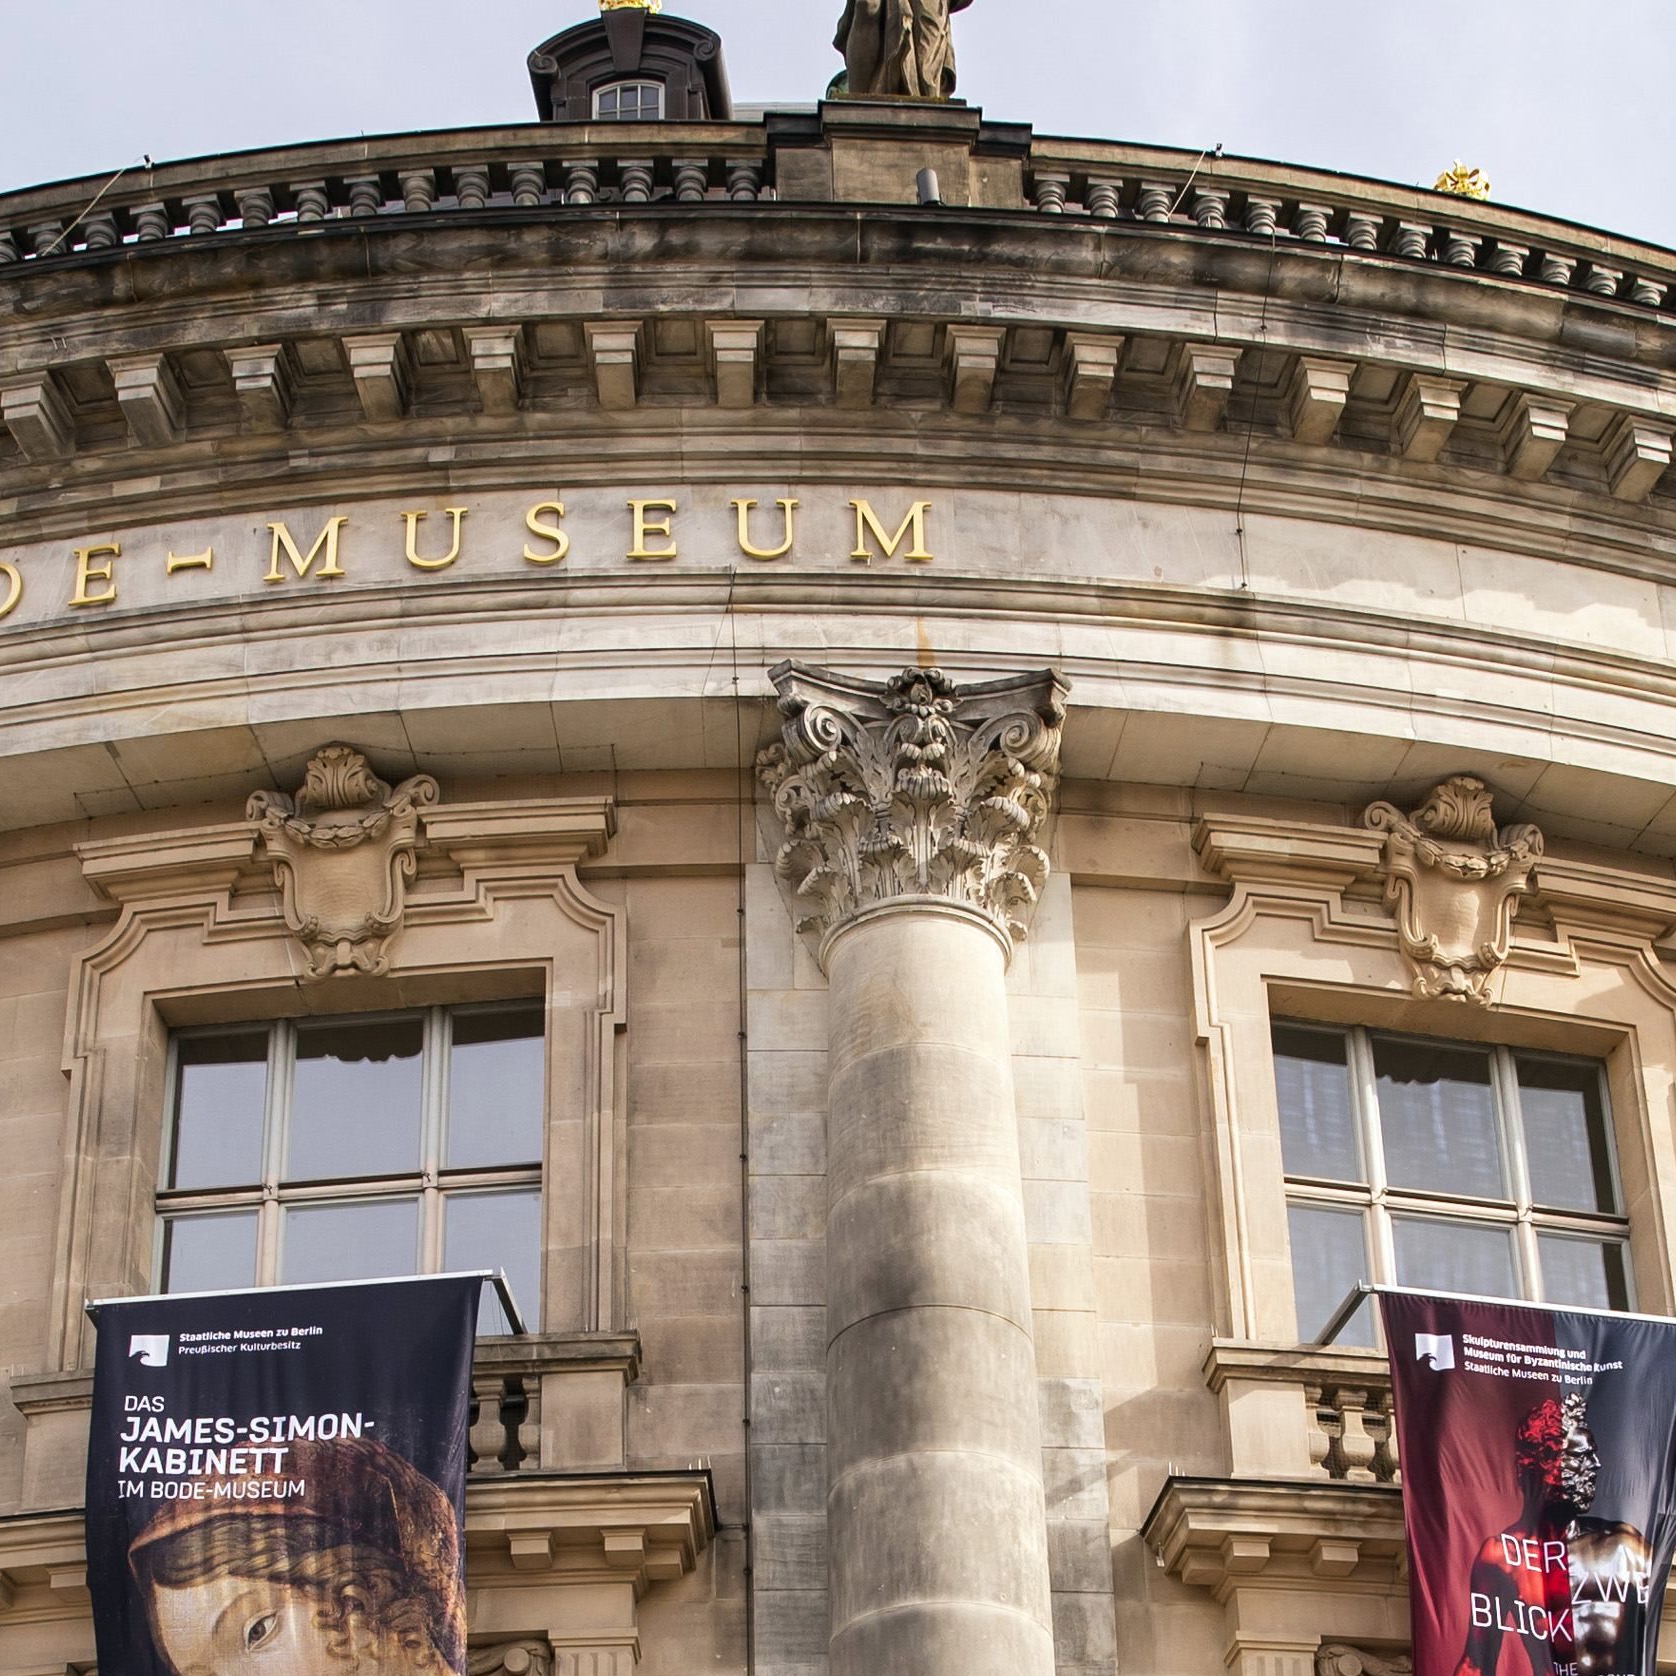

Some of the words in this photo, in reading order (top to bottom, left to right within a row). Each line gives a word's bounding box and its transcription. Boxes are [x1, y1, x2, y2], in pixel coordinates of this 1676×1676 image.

[179, 1331, 231, 1342] Staatliche
[233, 1329, 274, 1339] Museen
[275, 1328, 289, 1337] zu
[290, 1325, 323, 1336] Berlin
[178, 1344, 237, 1355] Preußischer
[240, 1340, 301, 1352] Kulturbesitz
[1462, 1334, 1566, 1359] Skulpturensammlung
[1567, 1350, 1586, 1360] und
[1464, 1346, 1504, 1363] Museum
[1506, 1353, 1522, 1364] für
[1524, 1355, 1593, 1372] Byzantinische
[1593, 1360, 1623, 1373] Kunst
[1464, 1361, 1509, 1377] Staatliche
[1512, 1367, 1549, 1381] Museen
[1551, 1373, 1562, 1383] zu
[1564, 1375, 1593, 1385] Berlin
[124, 1395, 165, 1413] DAS
[120, 1412, 375, 1444] JAMES-SIMON-
[119, 1446, 289, 1475] KABINETT
[117, 1479, 147, 1499] IM
[150, 1479, 306, 1500] BODE-MUSEUM
[1500, 1533, 1567, 1574] DER
[1470, 1592, 1573, 1643] BLICK
